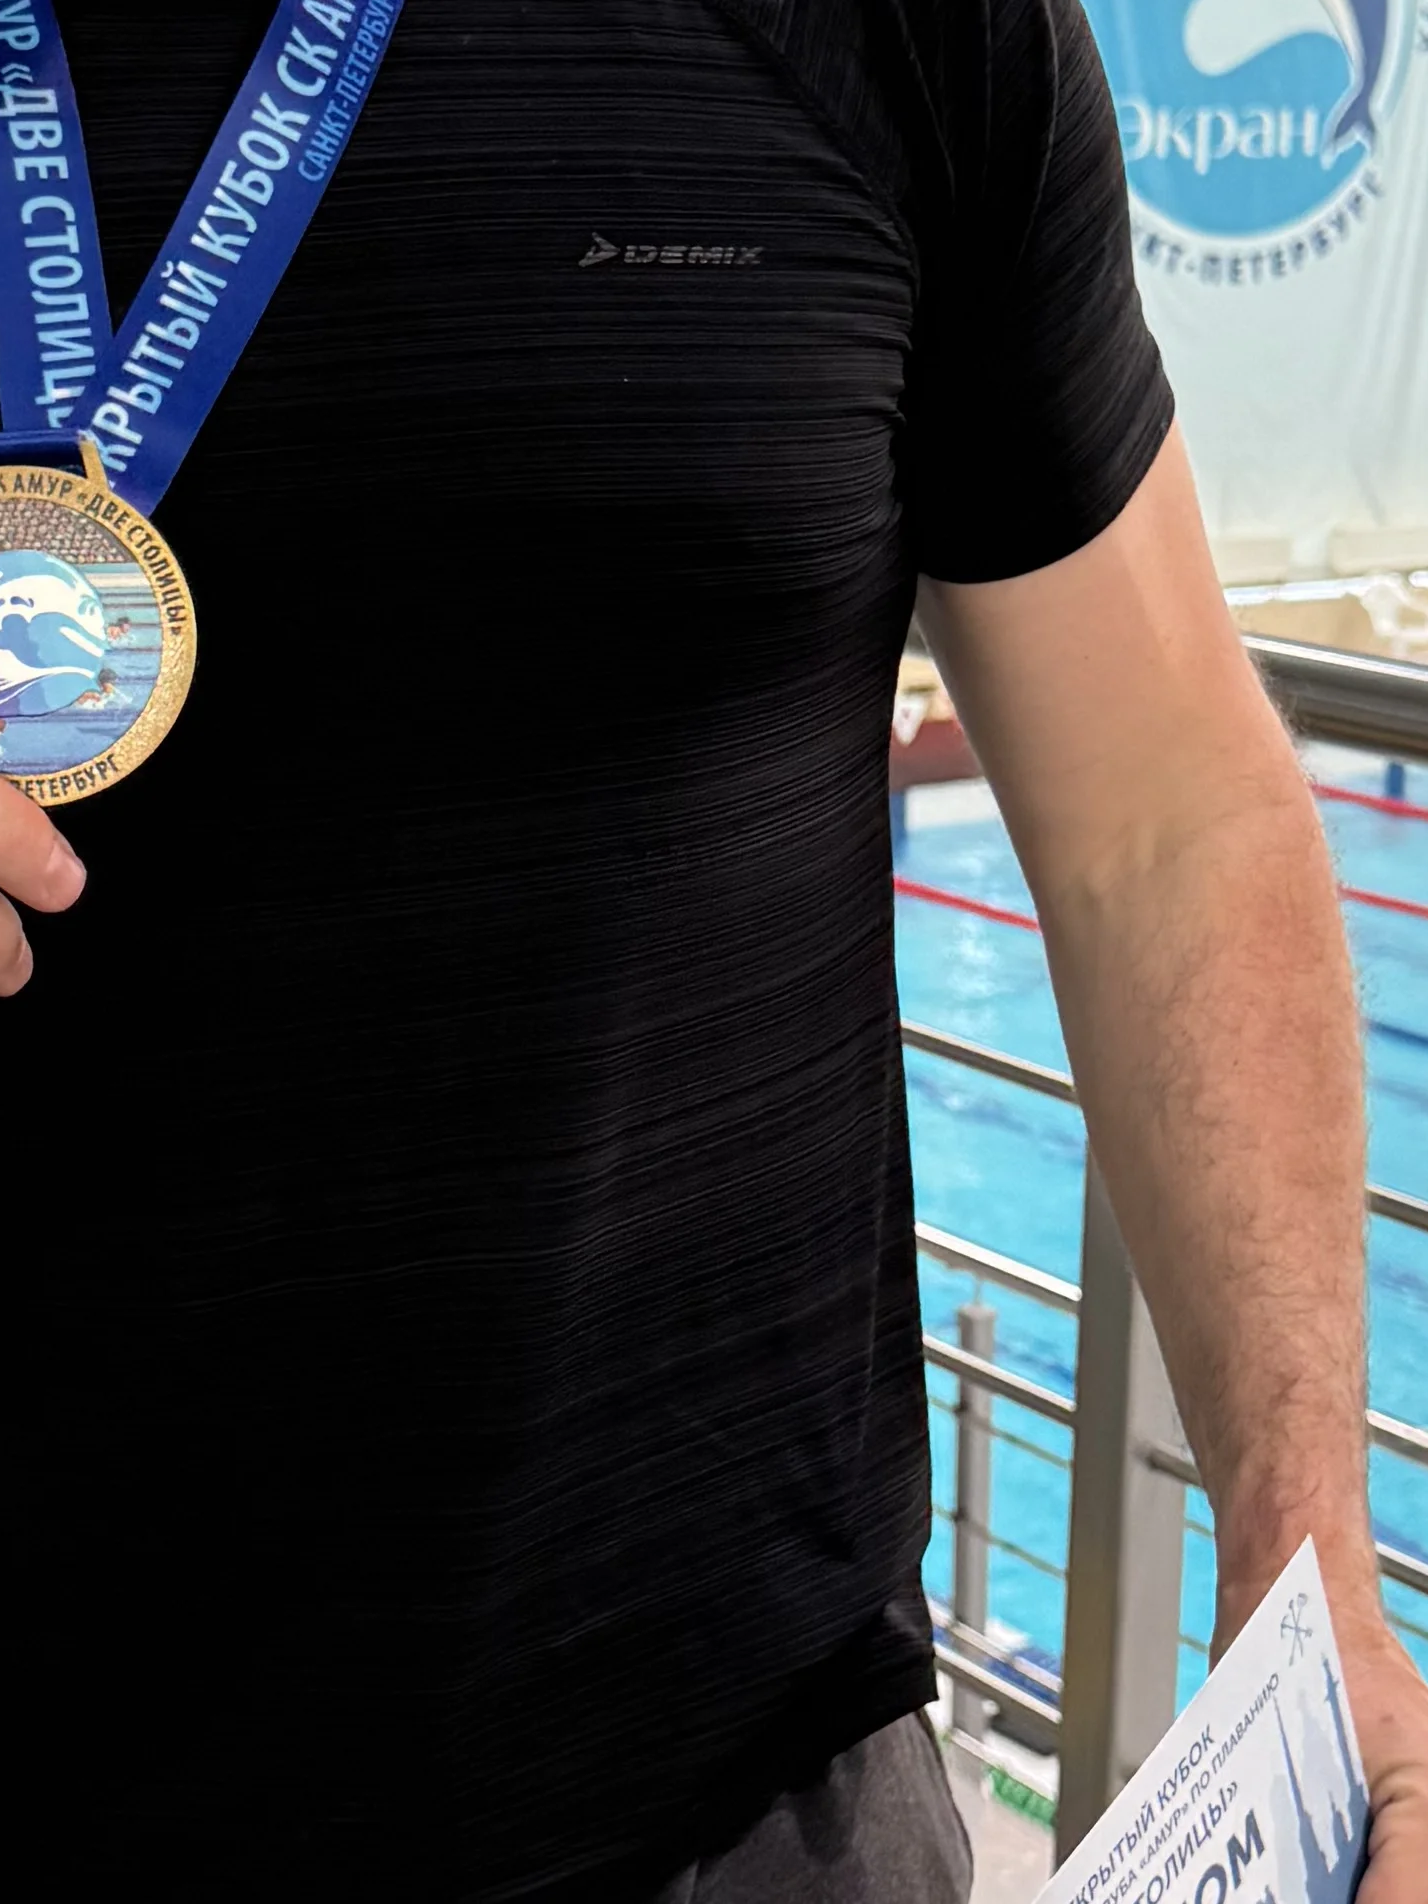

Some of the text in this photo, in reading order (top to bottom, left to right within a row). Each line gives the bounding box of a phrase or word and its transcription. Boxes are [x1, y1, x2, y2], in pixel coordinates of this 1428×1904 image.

[1120, 96, 1319, 176] Экран
[79, 260, 228, 487] КРЫТЫЙ
[190, 92, 311, 265] КУБОК
[277, 27, 339, 98] СК
[623, 245, 764, 264] DEMIX
[1132, 167, 1383, 287] КТ-ПЕТЕРБУРГ
[12, 473, 73, 498] АМУР
[76, 493, 130, 530] «ДВЕ
[1139, 1803, 1188, 1869] «АМУР»
[1190, 1770, 1210, 1804] ПО
[1211, 1673, 1279, 1773] ПЛАВАНИЮ
[1157, 1724, 1214, 1810] КУБОК
